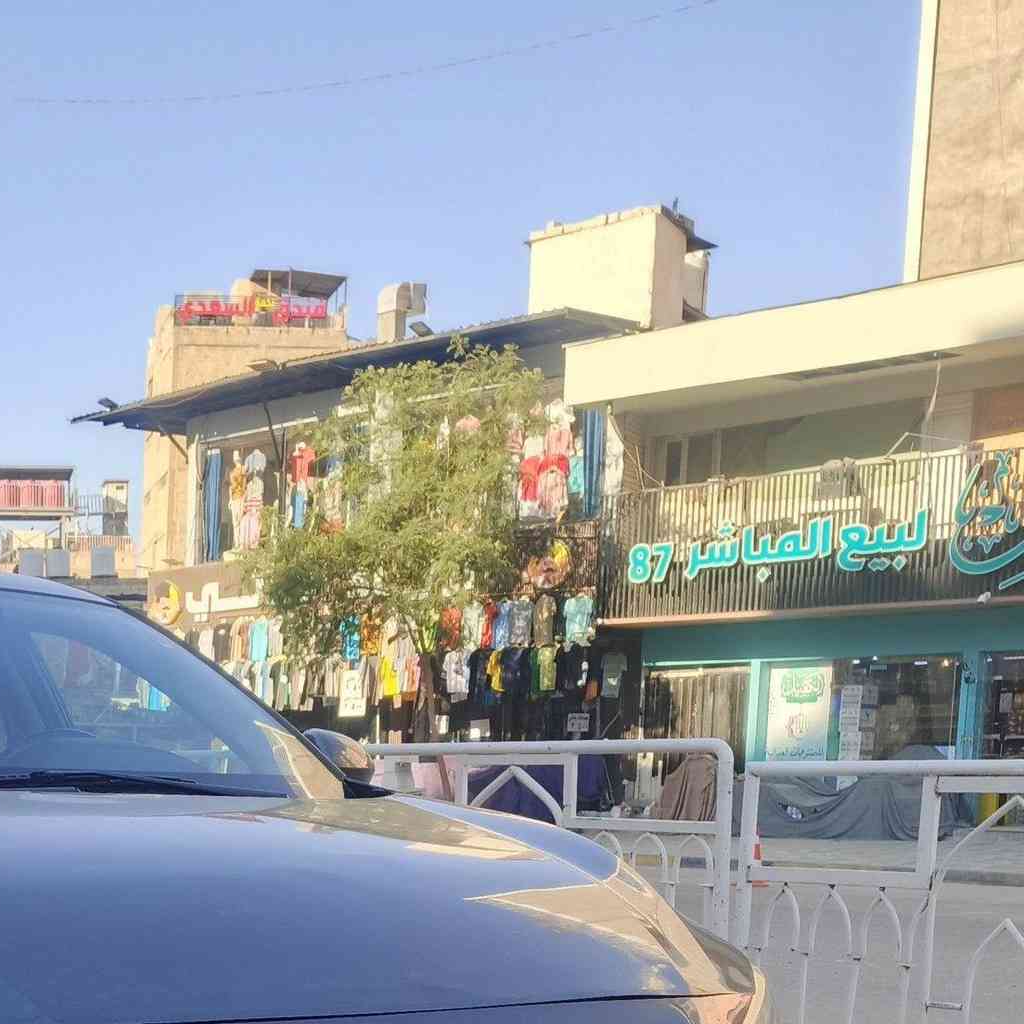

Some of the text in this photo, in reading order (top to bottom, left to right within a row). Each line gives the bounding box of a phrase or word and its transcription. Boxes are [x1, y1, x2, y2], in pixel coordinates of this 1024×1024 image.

[628, 543, 674, 584] 87
[685, 515, 833, 583] المباشر
[837, 508, 929, 573] لبيع
